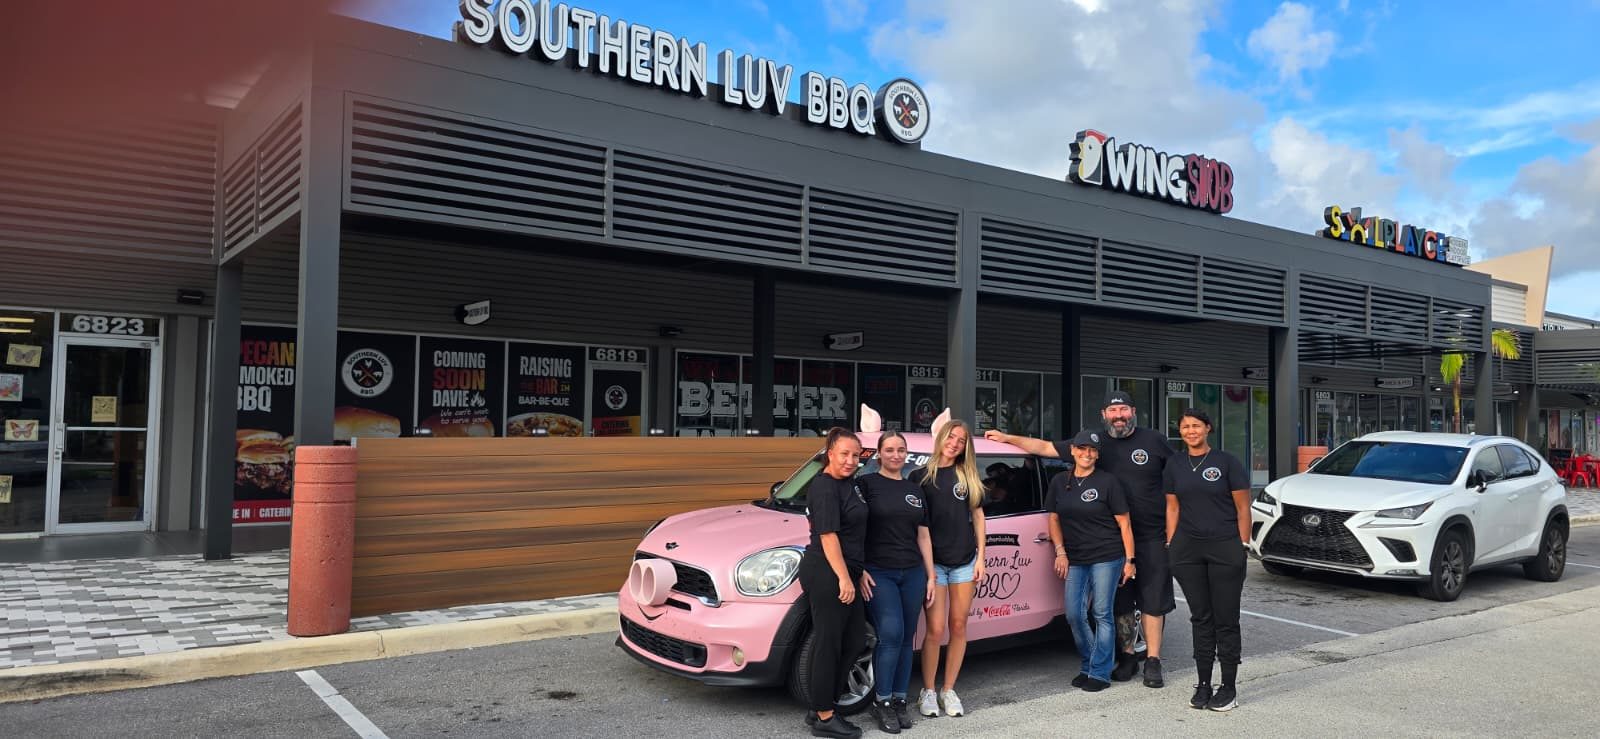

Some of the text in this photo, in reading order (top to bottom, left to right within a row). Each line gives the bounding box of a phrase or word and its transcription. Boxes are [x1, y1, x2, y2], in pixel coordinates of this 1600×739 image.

[461, 0, 876, 135] SOUTHERN LUV BBQ
[72, 314, 145, 335] 6823
[240, 341, 295, 366] ECAN
[433, 350, 486, 368] COMING
[596, 348, 638, 361] 6819
[239, 366, 295, 386] MOKED
[519, 355, 572, 378] RAISING
[911, 366, 940, 377] 6815
[976, 370, 993, 380] 811
[433, 368, 486, 390] SOON
[536, 377, 558, 395] BAR
[1167, 382, 1186, 391] 6807
[432, 390, 469, 407] DAVIE
[1009, 550, 1032, 571] Luv
